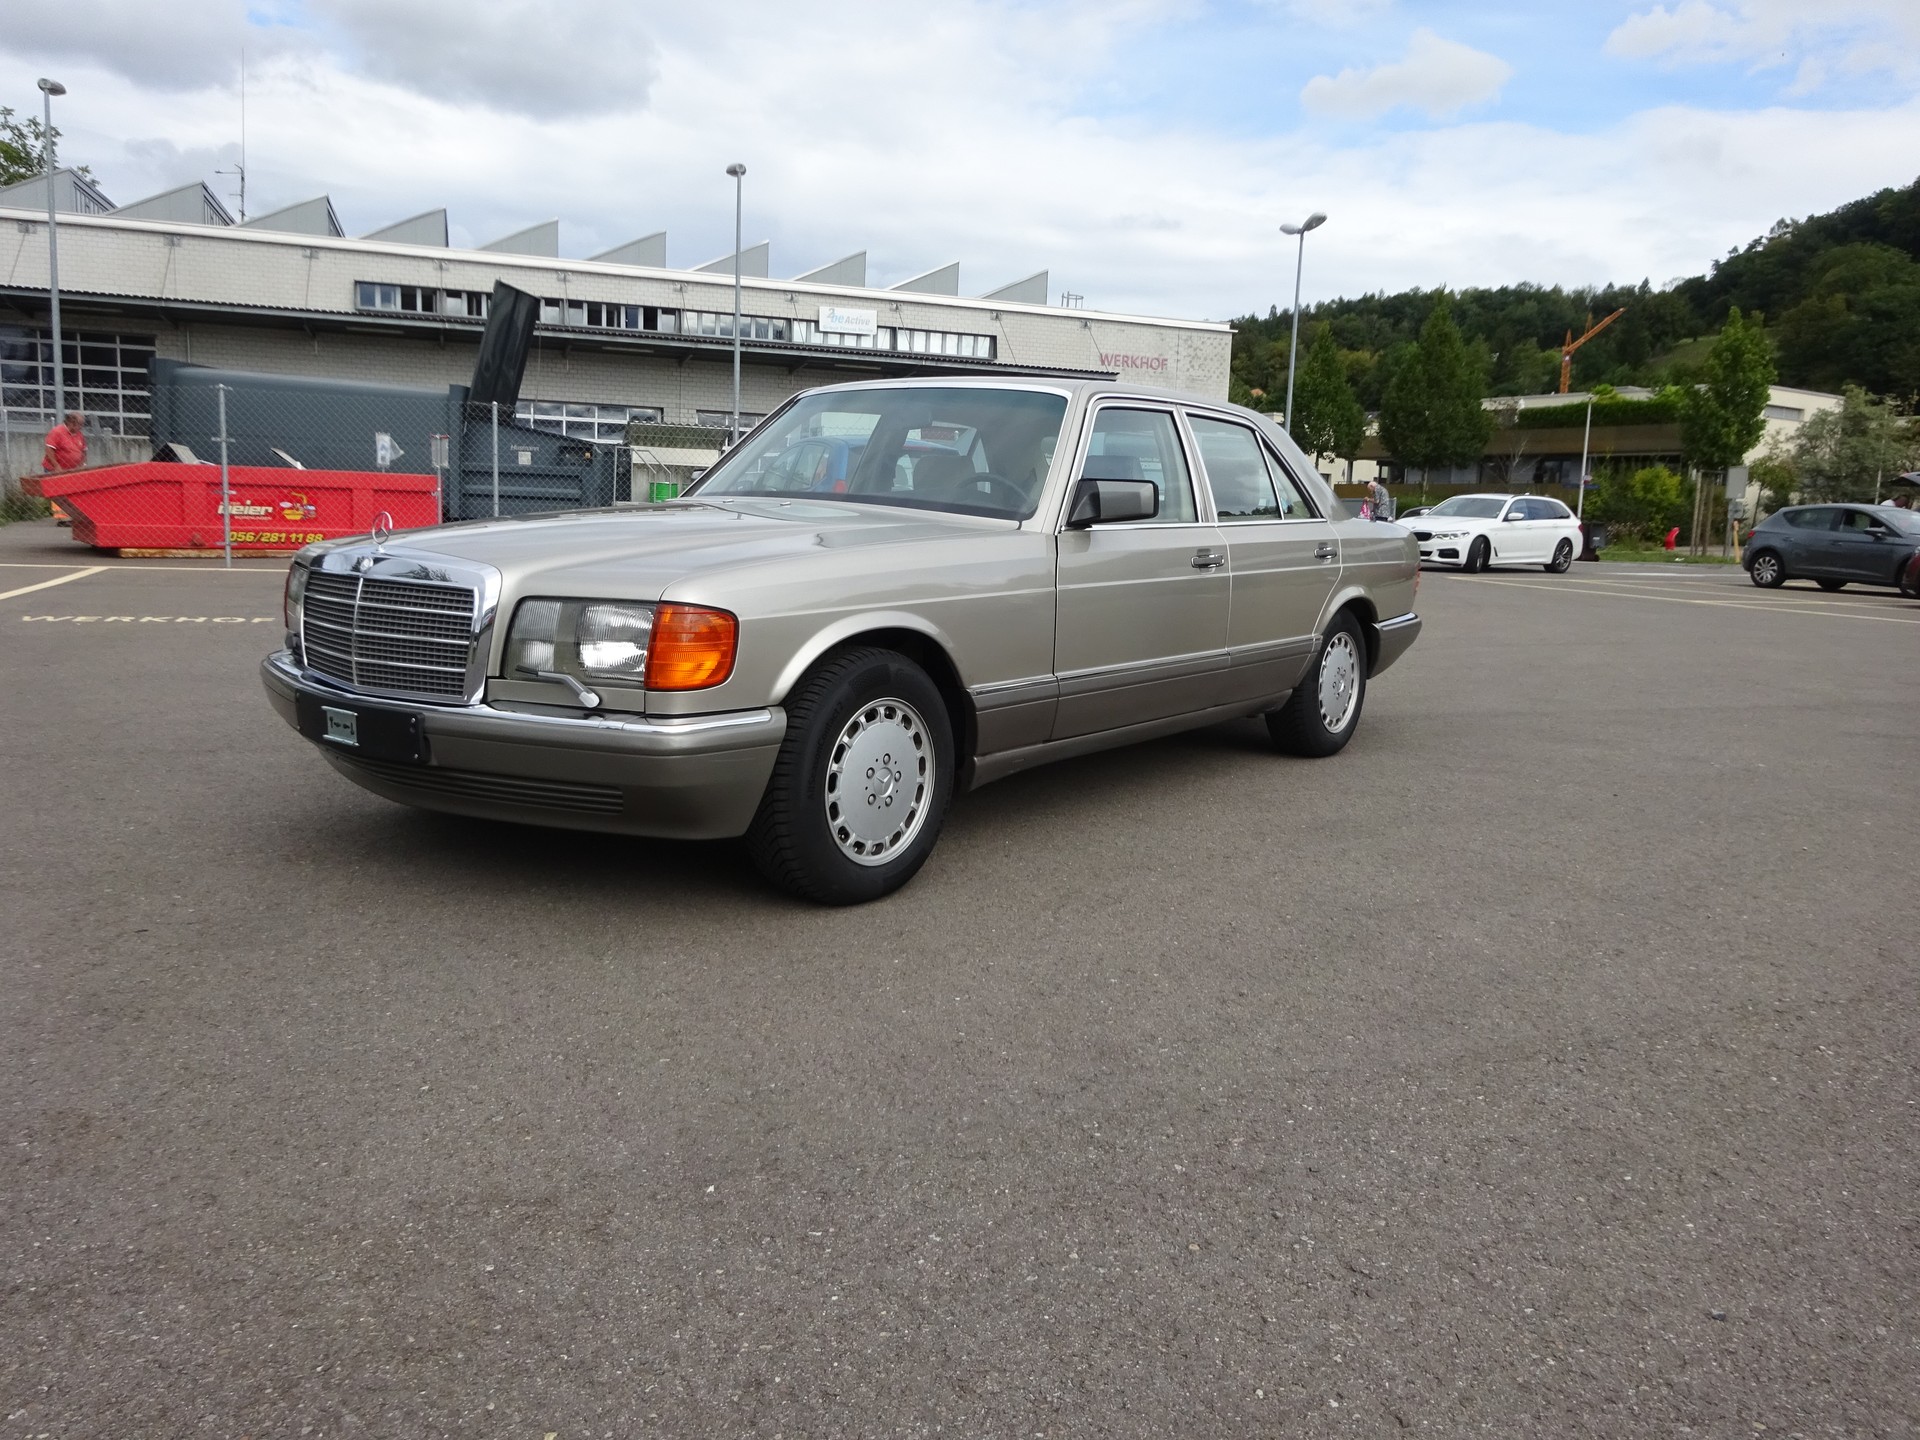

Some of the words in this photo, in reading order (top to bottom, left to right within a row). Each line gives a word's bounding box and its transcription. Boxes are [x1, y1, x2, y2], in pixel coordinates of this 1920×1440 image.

[844, 315, 871, 326] Active
[1100, 352, 1168, 371] WERKHOF
[22, 615, 275, 623] WERKHOF
